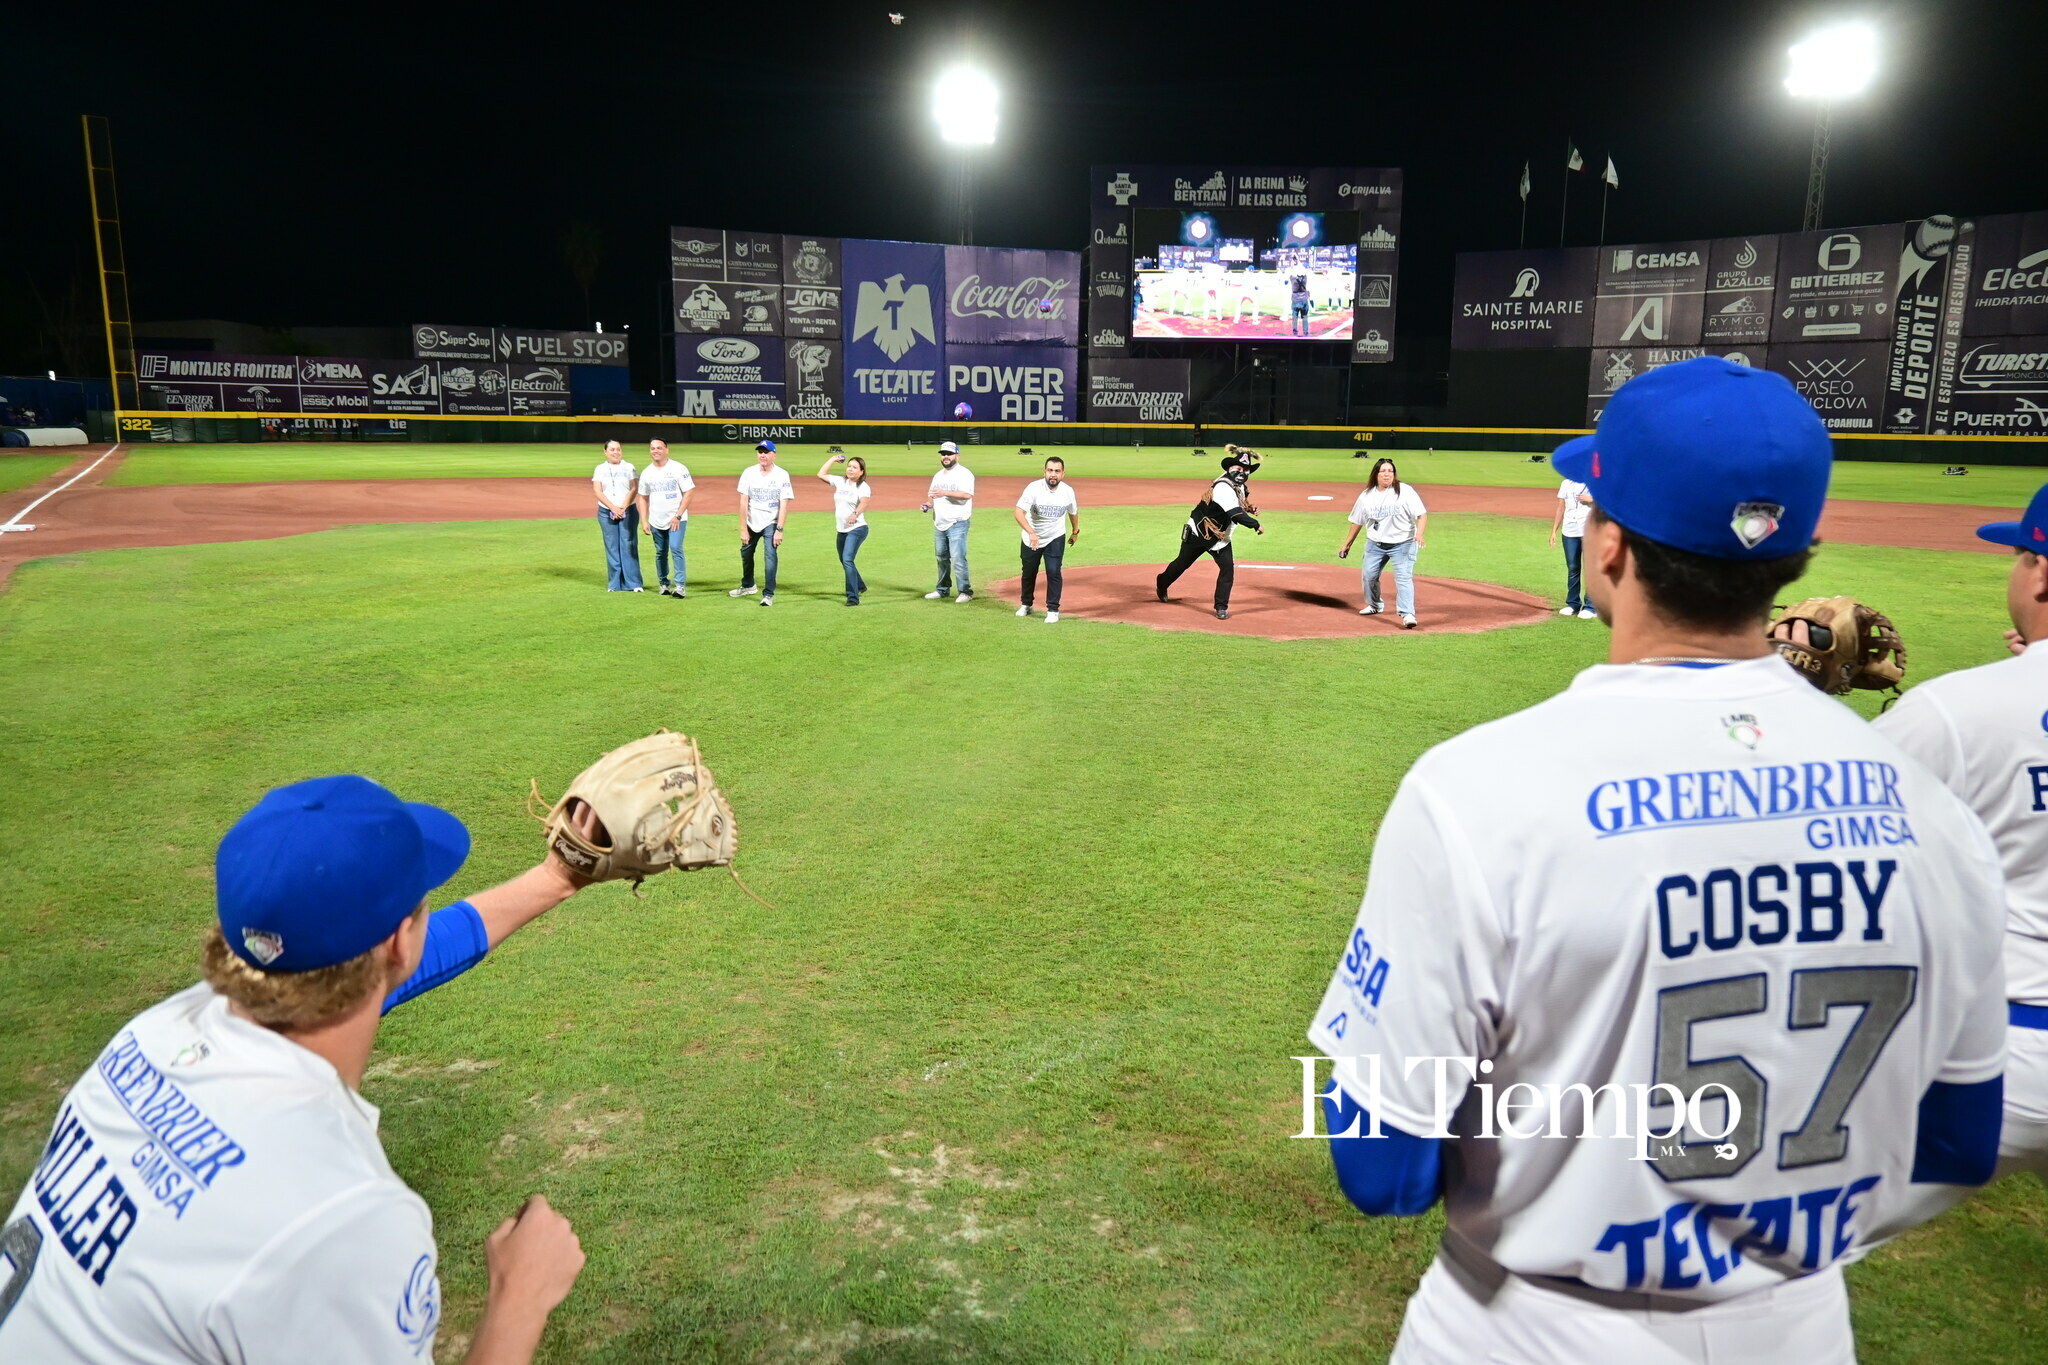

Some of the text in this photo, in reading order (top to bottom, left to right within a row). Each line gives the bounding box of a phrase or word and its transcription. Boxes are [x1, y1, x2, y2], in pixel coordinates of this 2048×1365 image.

[1239, 176, 1285, 190] LA REINA
[1174, 189, 1226, 202] BERTRAN
[1351, 185, 1392, 196] GRIJALVA
[1238, 193, 1307, 207] DE LAS CALES
[754, 243, 772, 255] GPL
[1635, 251, 1701, 270] CEMSA
[1100, 271, 1121, 280] CAL
[1716, 270, 1748, 279] GRUPO
[1790, 270, 1885, 290] GUTIERREZ
[1715, 275, 1772, 289] LAZALDE
[786, 289, 828, 307] JGM
[1462, 300, 1585, 318] SAINTE MARIE
[789, 317, 811, 325] VENTA
[1491, 320, 1552, 331] HOSPITAL
[1709, 315, 1766, 327] RYMCO
[802, 326, 824, 334] AUTOS
[1101, 329, 1115, 337] CAL
[1935, 243, 1970, 424] EL ESFUERZO ES RESULTADO
[517, 335, 624, 359] FUEL STOP
[711, 341, 747, 359] Ford
[1358, 342, 1388, 351] Pirasol
[1889, 297, 1913, 392] IMPULSANDO EL
[1903, 294, 1939, 400] DEPORTE
[1647, 350, 1706, 363] HARINA
[170, 360, 294, 380] MONTAJES FRONTERA
[316, 362, 364, 380] MENA
[697, 365, 762, 375] AUTOMOTRIZ
[442, 375, 476, 385] BUTACA
[483, 375, 507, 393] 91.5
[510, 377, 566, 392] Electrolit
[708, 373, 763, 383] MONCLOVA
[852, 367, 938, 395] TECATE
[948, 364, 1065, 394] POWER
[1104, 382, 1135, 390] TOGETHER
[1796, 380, 1855, 394] PASEO
[302, 395, 369, 407] ESSEX Mobil
[720, 400, 782, 410] MONCLOVA
[797, 392, 832, 408] Little
[881, 396, 909, 404] LIGHT
[1092, 391, 1184, 408] GREENBRIER
[459, 404, 506, 412] monclova.com
[787, 404, 838, 420] Caesars
[1000, 394, 1065, 422] ADE
[1139, 406, 1184, 421] GIMSA
[122, 418, 153, 432] 322
[1827, 418, 1874, 429] COAHUILA
[1952, 410, 2033, 428] PUERTO
[742, 426, 805, 439] FIBRANET
[1353, 431, 1374, 442] 410
[1586, 760, 1908, 836] GREENBRIER
[1805, 815, 1917, 851] GIMSA
[1655, 859, 1896, 959] COSBY
[1652, 965, 1918, 1182] 57
[132, 1141, 196, 1221] GIMSA
[1594, 1176, 1883, 1292] TECATE
